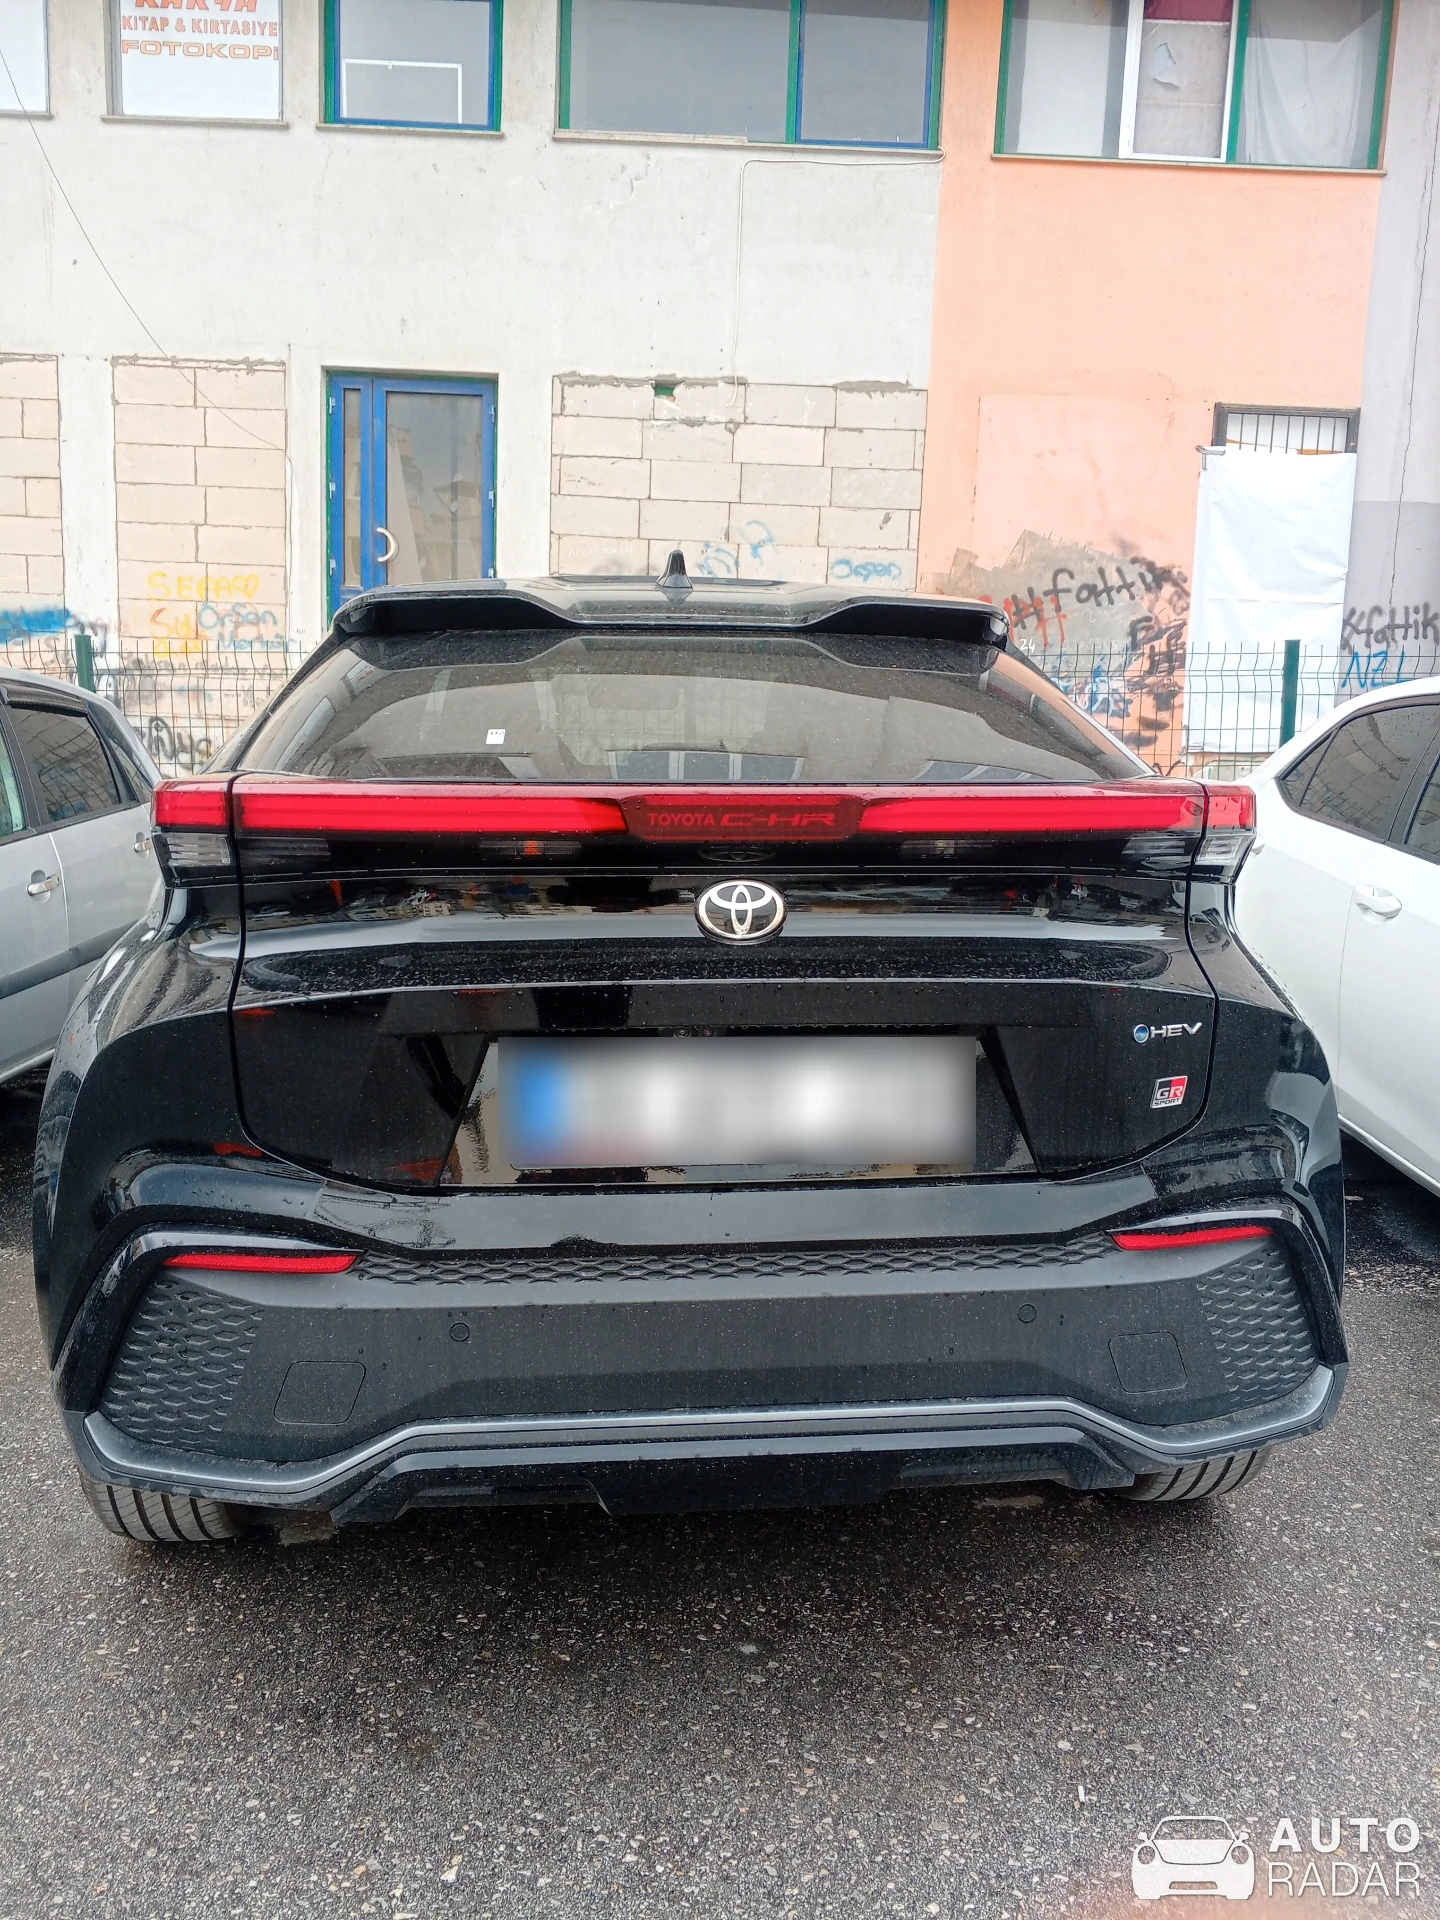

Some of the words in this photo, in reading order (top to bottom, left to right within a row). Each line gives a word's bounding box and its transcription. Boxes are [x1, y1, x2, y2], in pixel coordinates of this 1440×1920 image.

[175, 18, 186, 32] &
[650, 813, 715, 826] TOYOTA
[720, 813, 835, 826] C-HR
[1150, 1022, 1202, 1039] HEV
[1156, 1085, 1184, 1100] GR
[1154, 1099, 1181, 1107] SPORT
